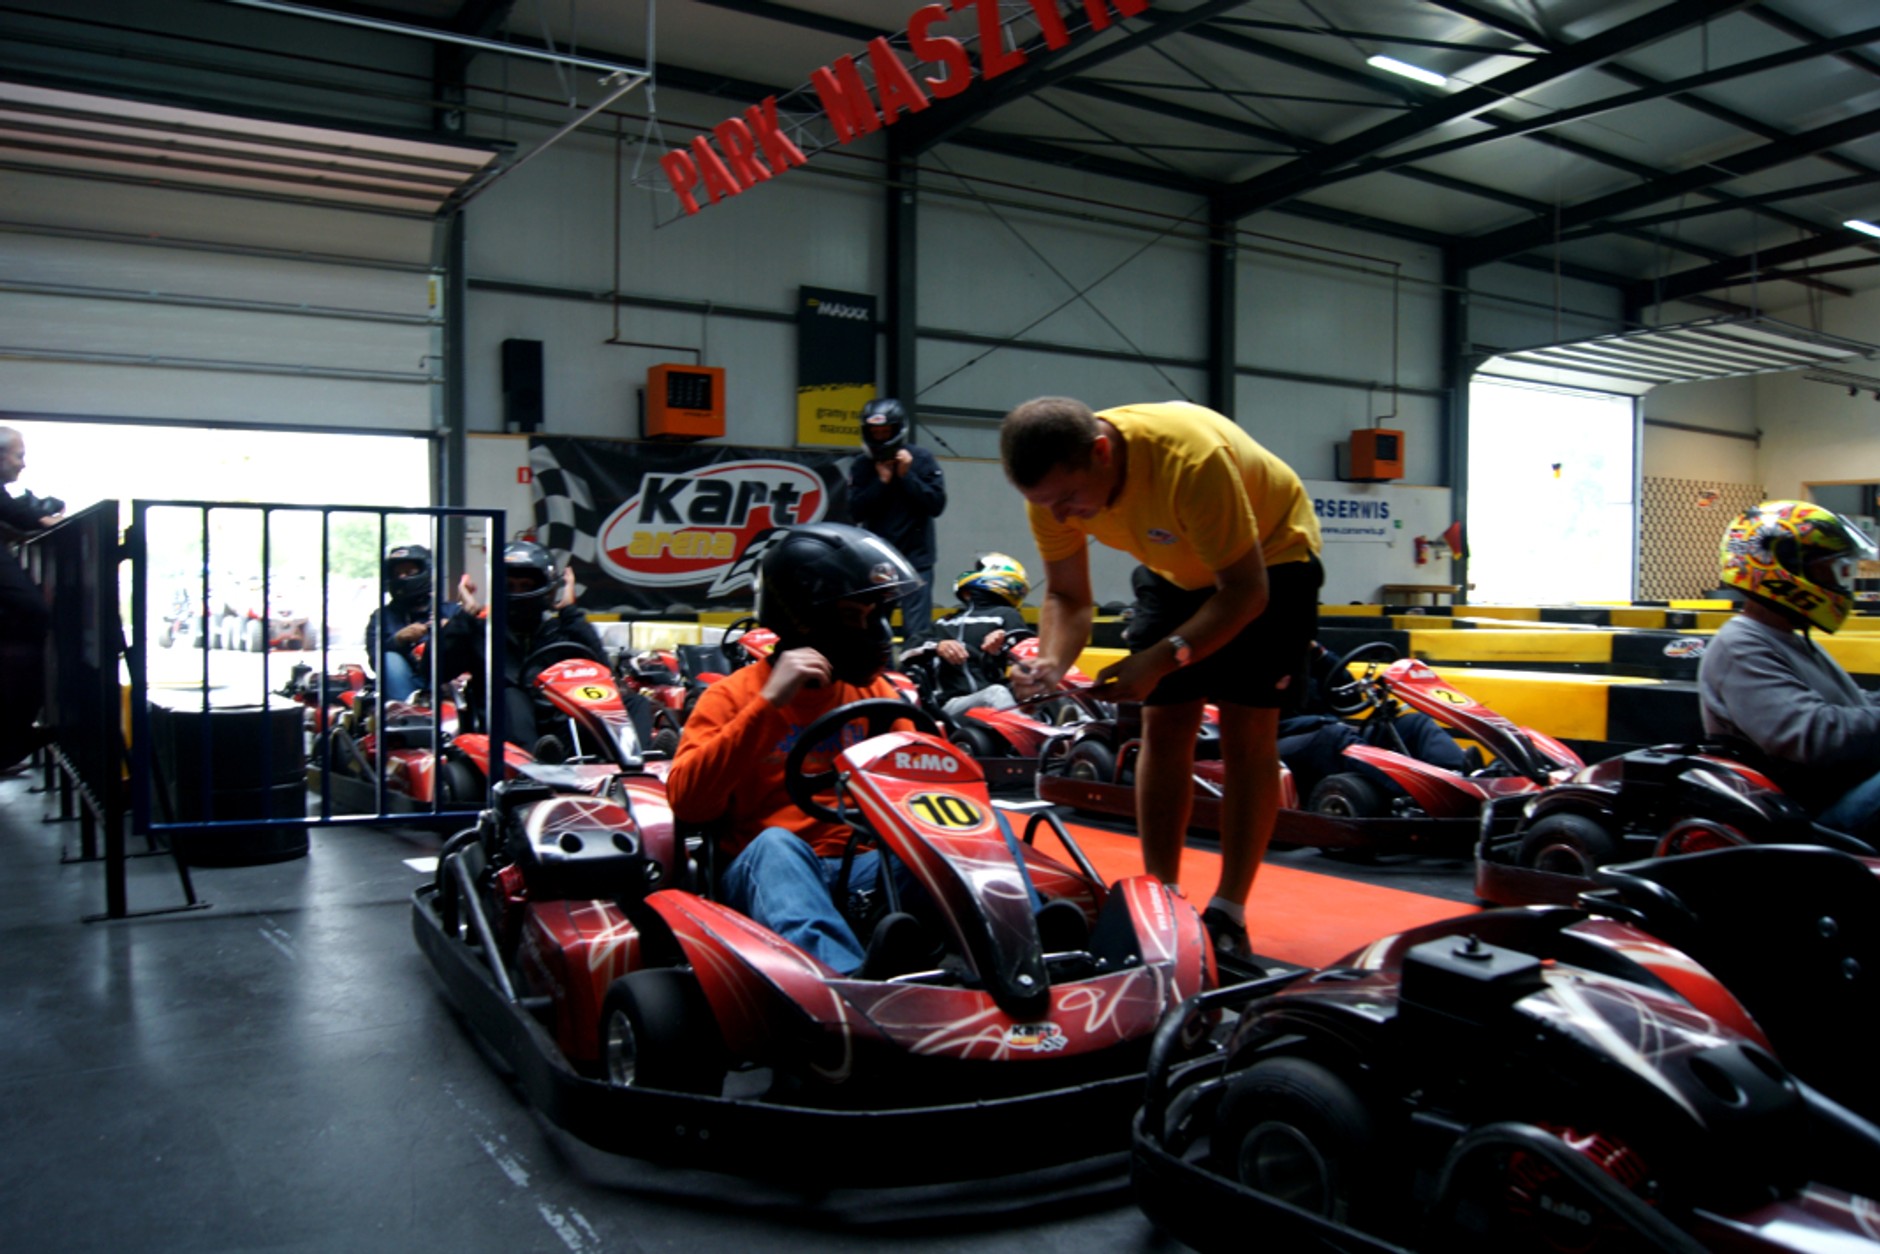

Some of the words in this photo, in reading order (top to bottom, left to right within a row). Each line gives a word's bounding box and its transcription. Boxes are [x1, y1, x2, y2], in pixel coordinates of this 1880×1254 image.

[659, 95, 808, 216] PARK
[810, 0, 1149, 145] MASZ
[637, 477, 801, 525] Kart
[628, 532, 735, 558] arena
[583, 687, 602, 700] 6
[1435, 689, 1465, 704] 2
[909, 795, 981, 826] 10
